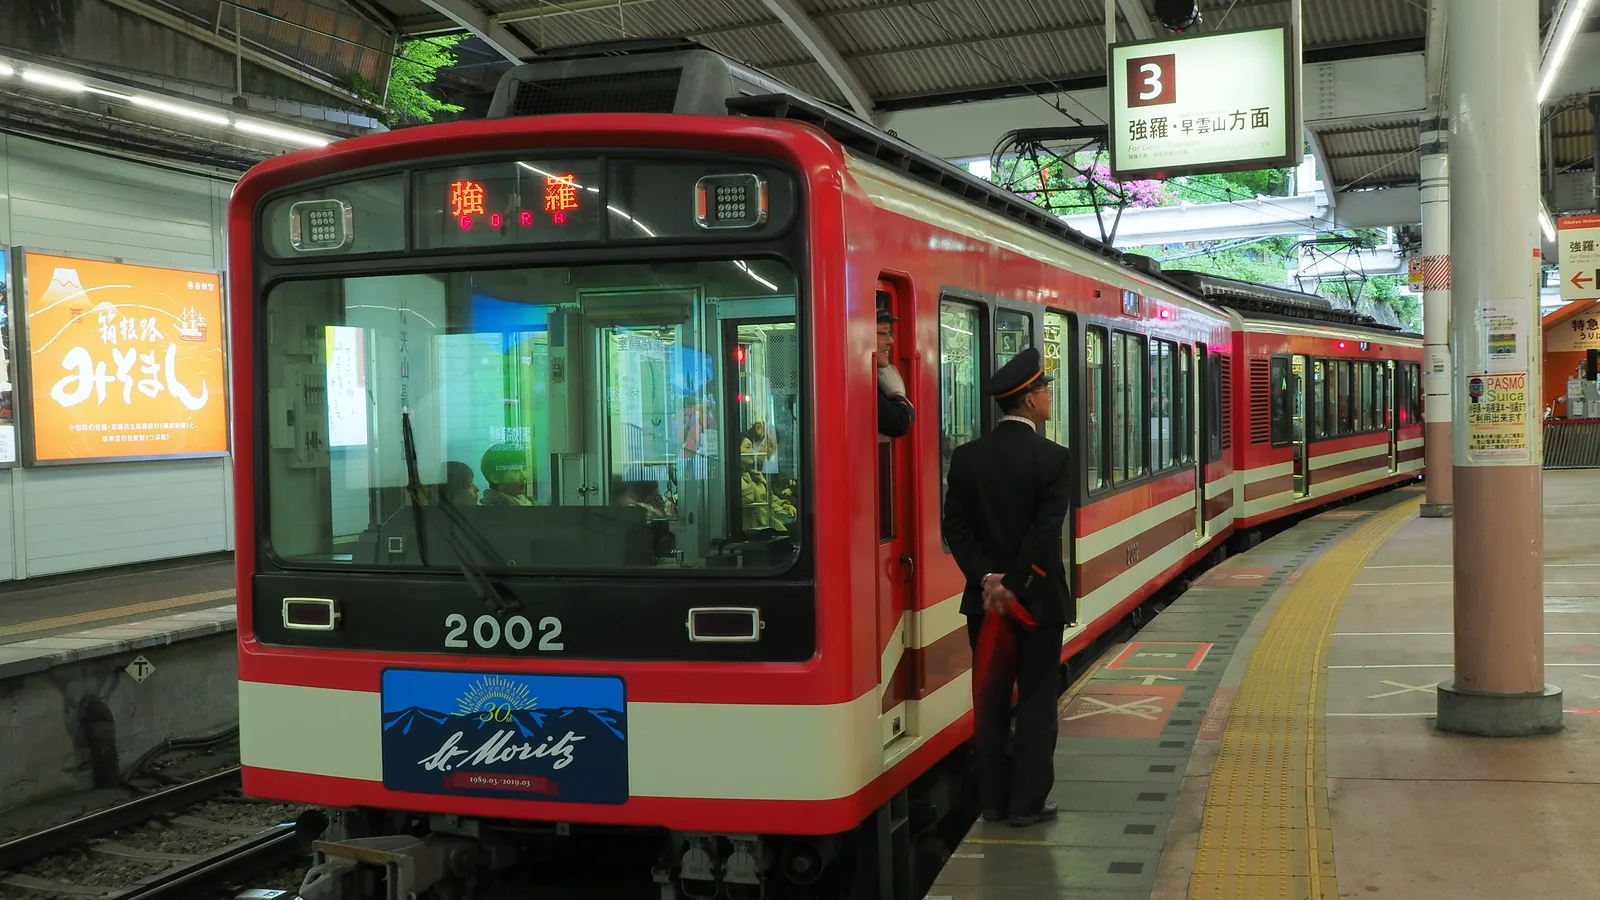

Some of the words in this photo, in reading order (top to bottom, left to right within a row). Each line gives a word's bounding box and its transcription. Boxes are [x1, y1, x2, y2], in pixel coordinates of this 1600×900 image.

[1139, 63, 1162, 100] 3
[1129, 107, 1270, 141] 強羅・早雲山方面
[451, 174, 578, 216] 強羅
[460, 210, 566, 230] GORA
[98, 310, 165, 344] 箱根路
[1572, 319, 1599, 331] 特急
[1487, 376, 1525, 390] PASMO
[1487, 389, 1523, 402] Suica
[445, 613, 564, 651] 2002
[417, 730, 468, 772] St.
[456, 729, 586, 770] Moritz
